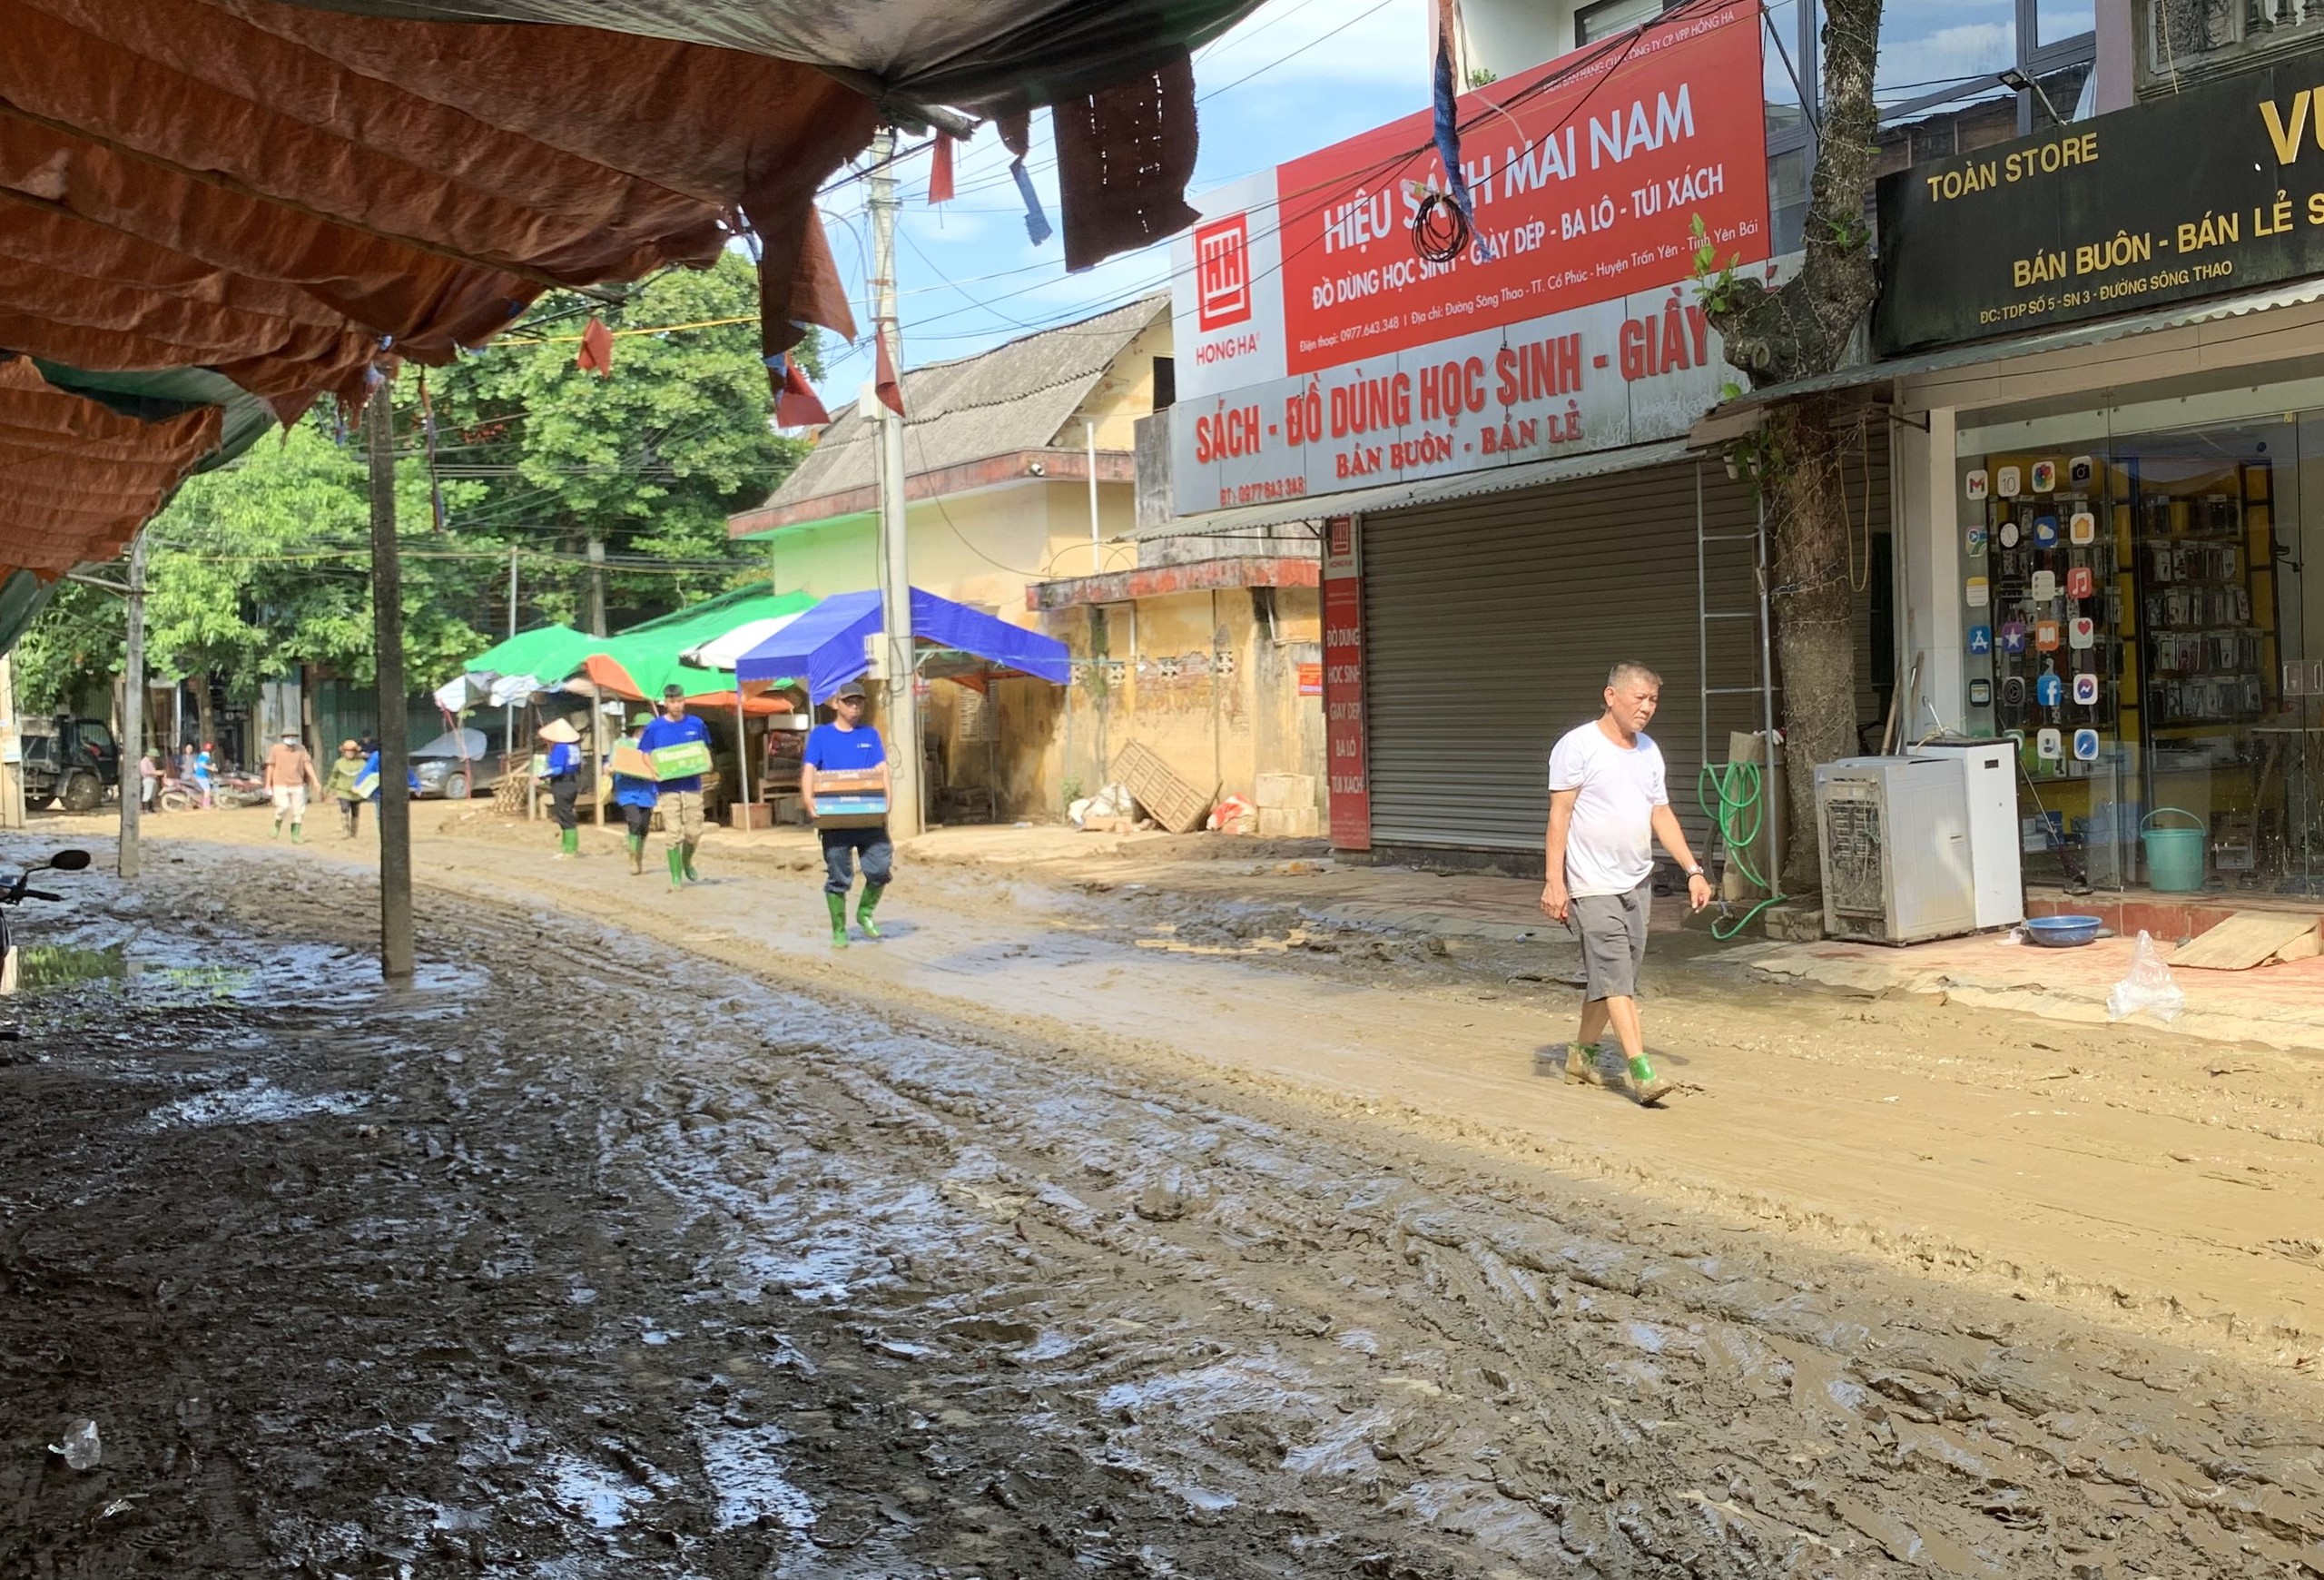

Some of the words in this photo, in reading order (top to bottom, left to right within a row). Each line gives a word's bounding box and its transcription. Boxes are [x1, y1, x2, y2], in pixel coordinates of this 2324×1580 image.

[1651, 39, 1661, 51] TY
[1662, 34, 1674, 47] CP
[1675, 27, 1689, 43] VPP
[1927, 160, 1997, 202] TOÀN
[2005, 133, 2099, 183] STORE
[2259, 85, 2324, 165] V
[1324, 187, 1393, 254] HIỆU
[1403, 155, 1493, 231] SÁH
[1504, 125, 1577, 198] MAI
[1590, 83, 1695, 171] NAM
[1312, 274, 1334, 311] ĐỒ
[1337, 266, 1380, 303] DÙNG
[1383, 257, 1416, 293] HỌC
[1514, 214, 1545, 254] DÉP
[1561, 208, 1589, 241] BA
[1590, 194, 1615, 232] LÔ
[1631, 175, 1661, 219] TÚI
[1667, 163, 1723, 210] XÁCH
[1476, 290, 1499, 309] Sông
[1501, 285, 1523, 301] Thao
[1565, 270, 1588, 286] Phúc
[1596, 259, 1629, 279] Huyện
[1657, 243, 1678, 261] Yên
[1714, 228, 1736, 243] Yên
[1739, 218, 1758, 237] Bái
[2014, 249, 2067, 288] BÁN
[2076, 229, 2151, 275] BUÔN
[2177, 210, 2239, 253] BÁN
[2254, 189, 2293, 237] LẺ
[2002, 303, 2027, 320] TDP
[2028, 293, 2046, 315] SỐ
[2048, 299, 2055, 311] 5
[2063, 292, 2081, 309] SN
[2083, 290, 2090, 304] 3
[2100, 276, 2147, 301] ĐƯỜNG
[2150, 272, 2190, 291] SÔNG
[2192, 260, 2233, 281] THAO
[1196, 399, 1261, 465] SÁCH
[1285, 372, 1323, 447] ĐỒ
[1331, 368, 1412, 439] DÙNG
[1420, 355, 1486, 428] HỌC
[1495, 332, 1582, 407] SINH
[1335, 442, 1383, 479] BÁN
[1389, 430, 1453, 470] BUÔN
[1481, 412, 1538, 455] BÁN
[1548, 399, 1582, 443] LẺ
